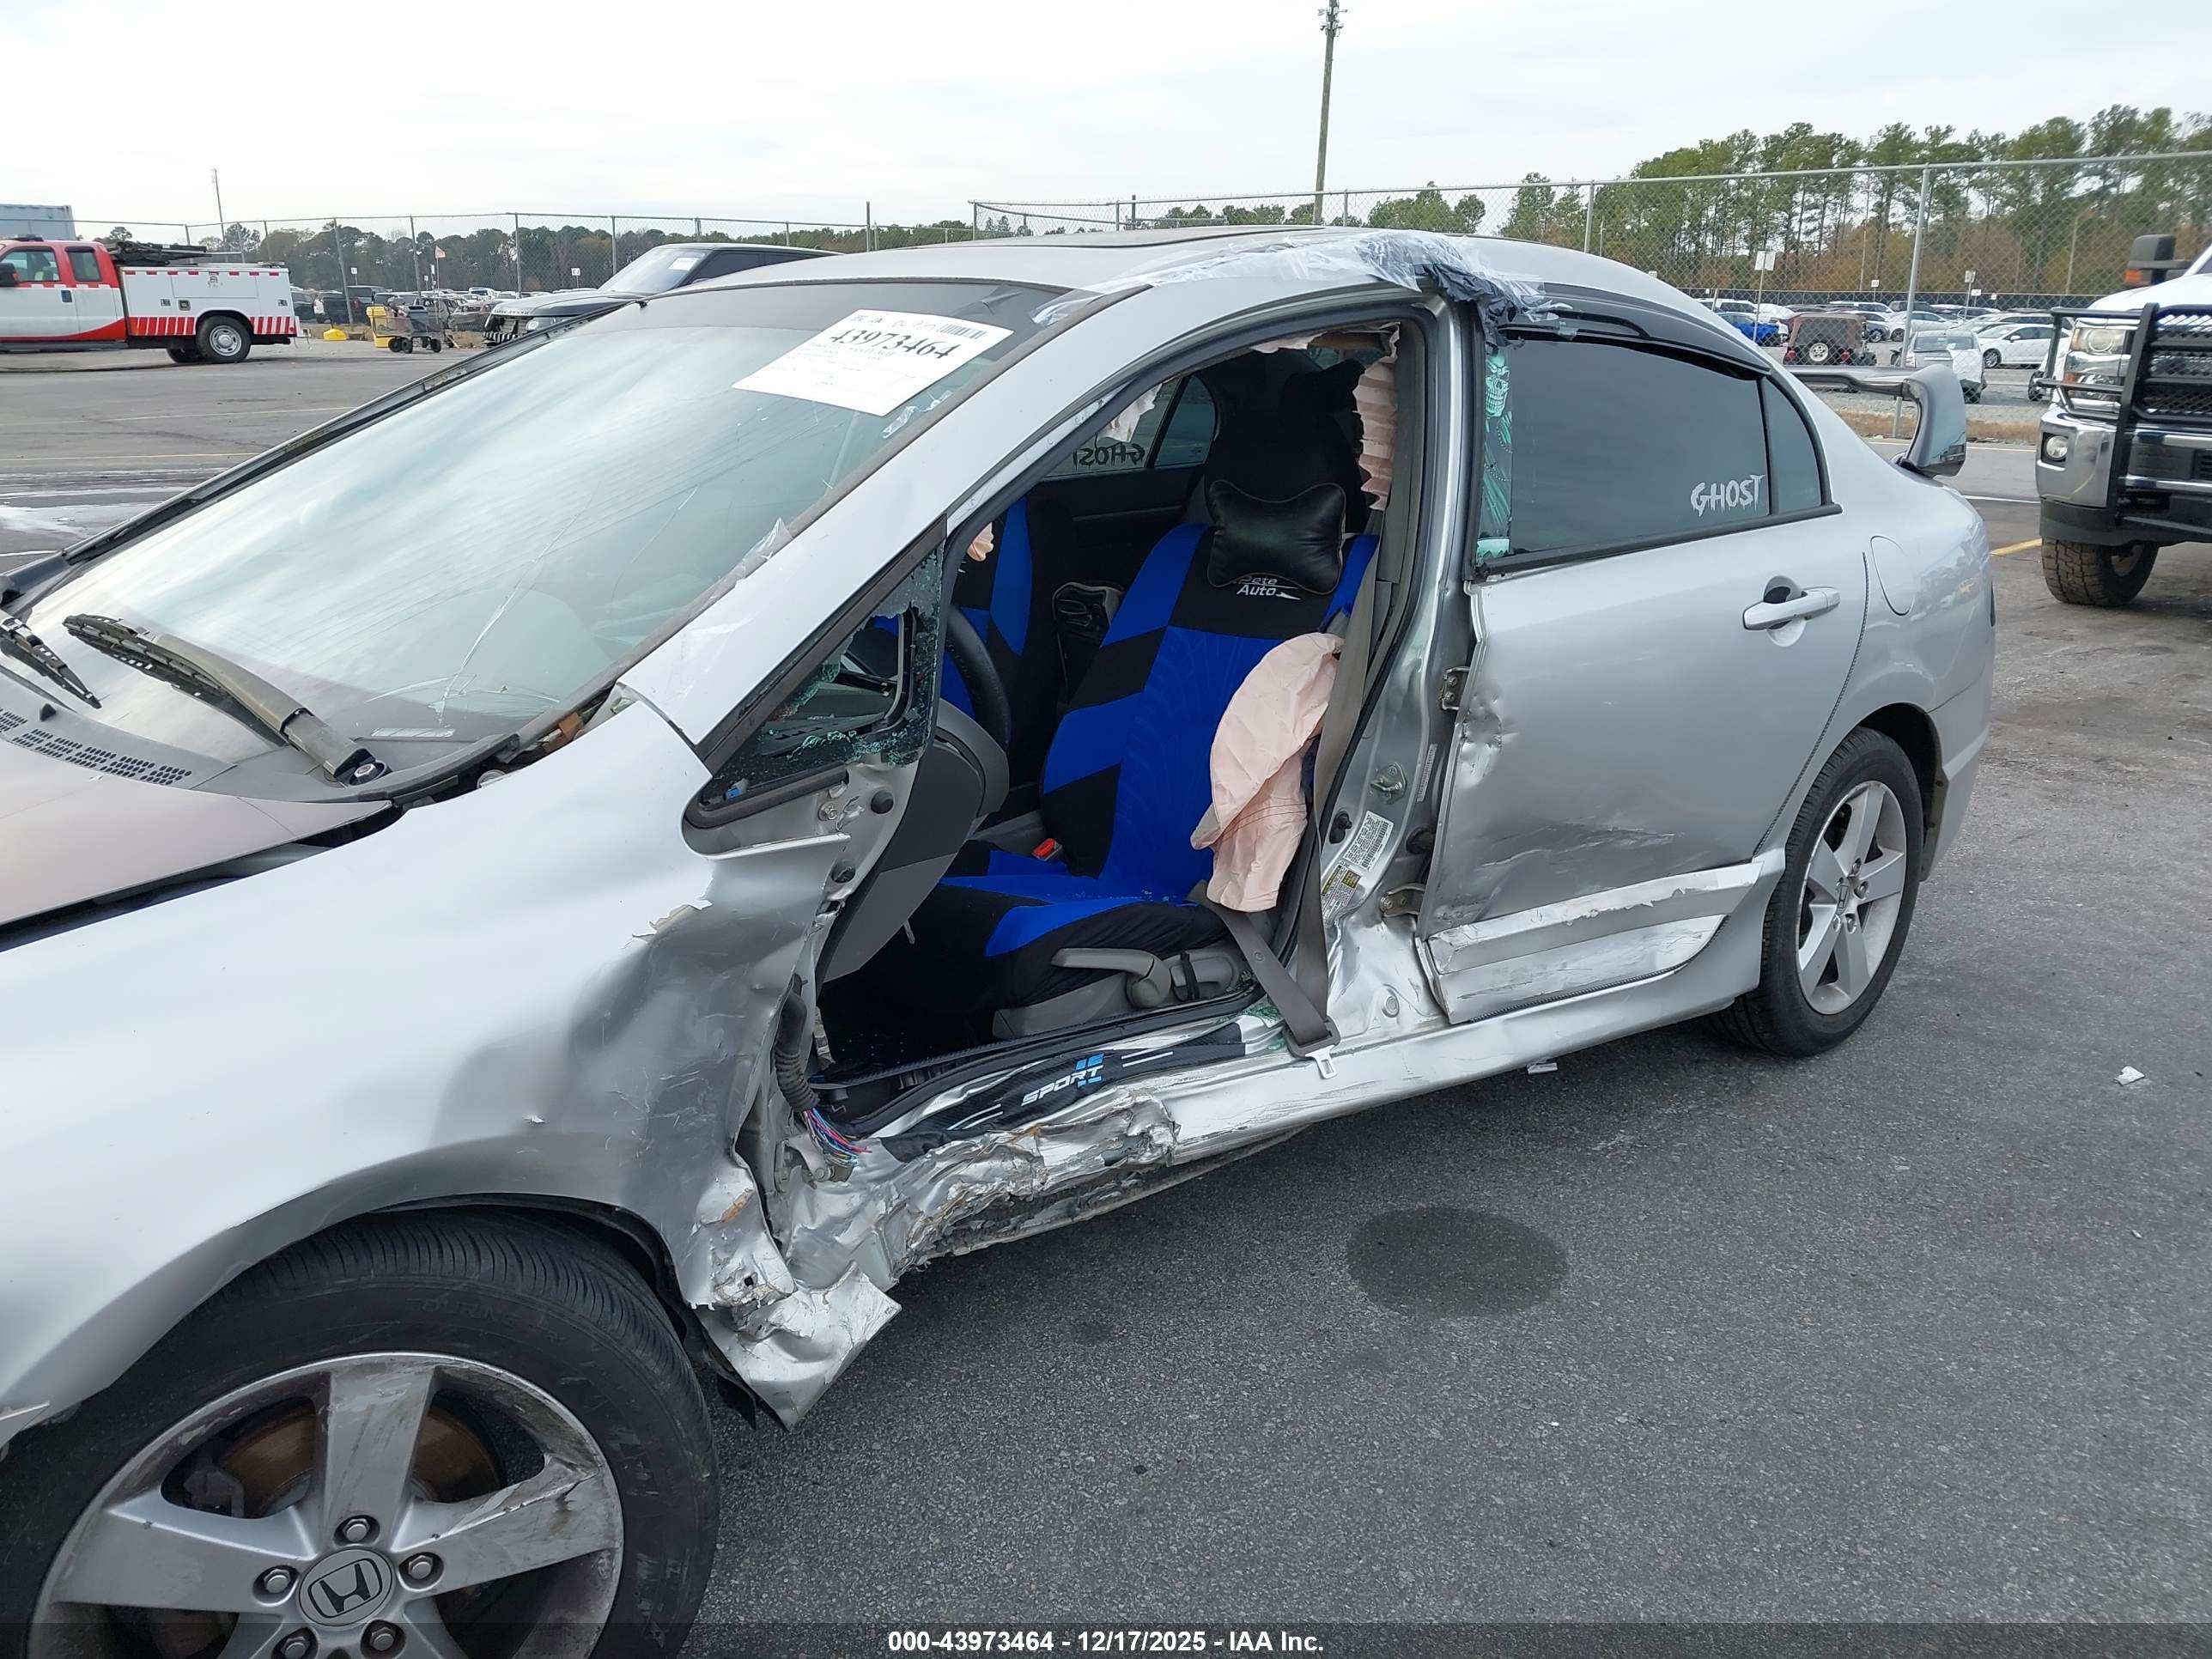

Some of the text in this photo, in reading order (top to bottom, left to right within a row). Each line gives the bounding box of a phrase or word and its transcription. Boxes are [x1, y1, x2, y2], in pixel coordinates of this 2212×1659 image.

[830, 329, 961, 359] 43973464
[1690, 474, 1766, 518] GHOST
[1237, 585, 1277, 596] Auto
[1020, 1064, 1105, 1107] SPORT
